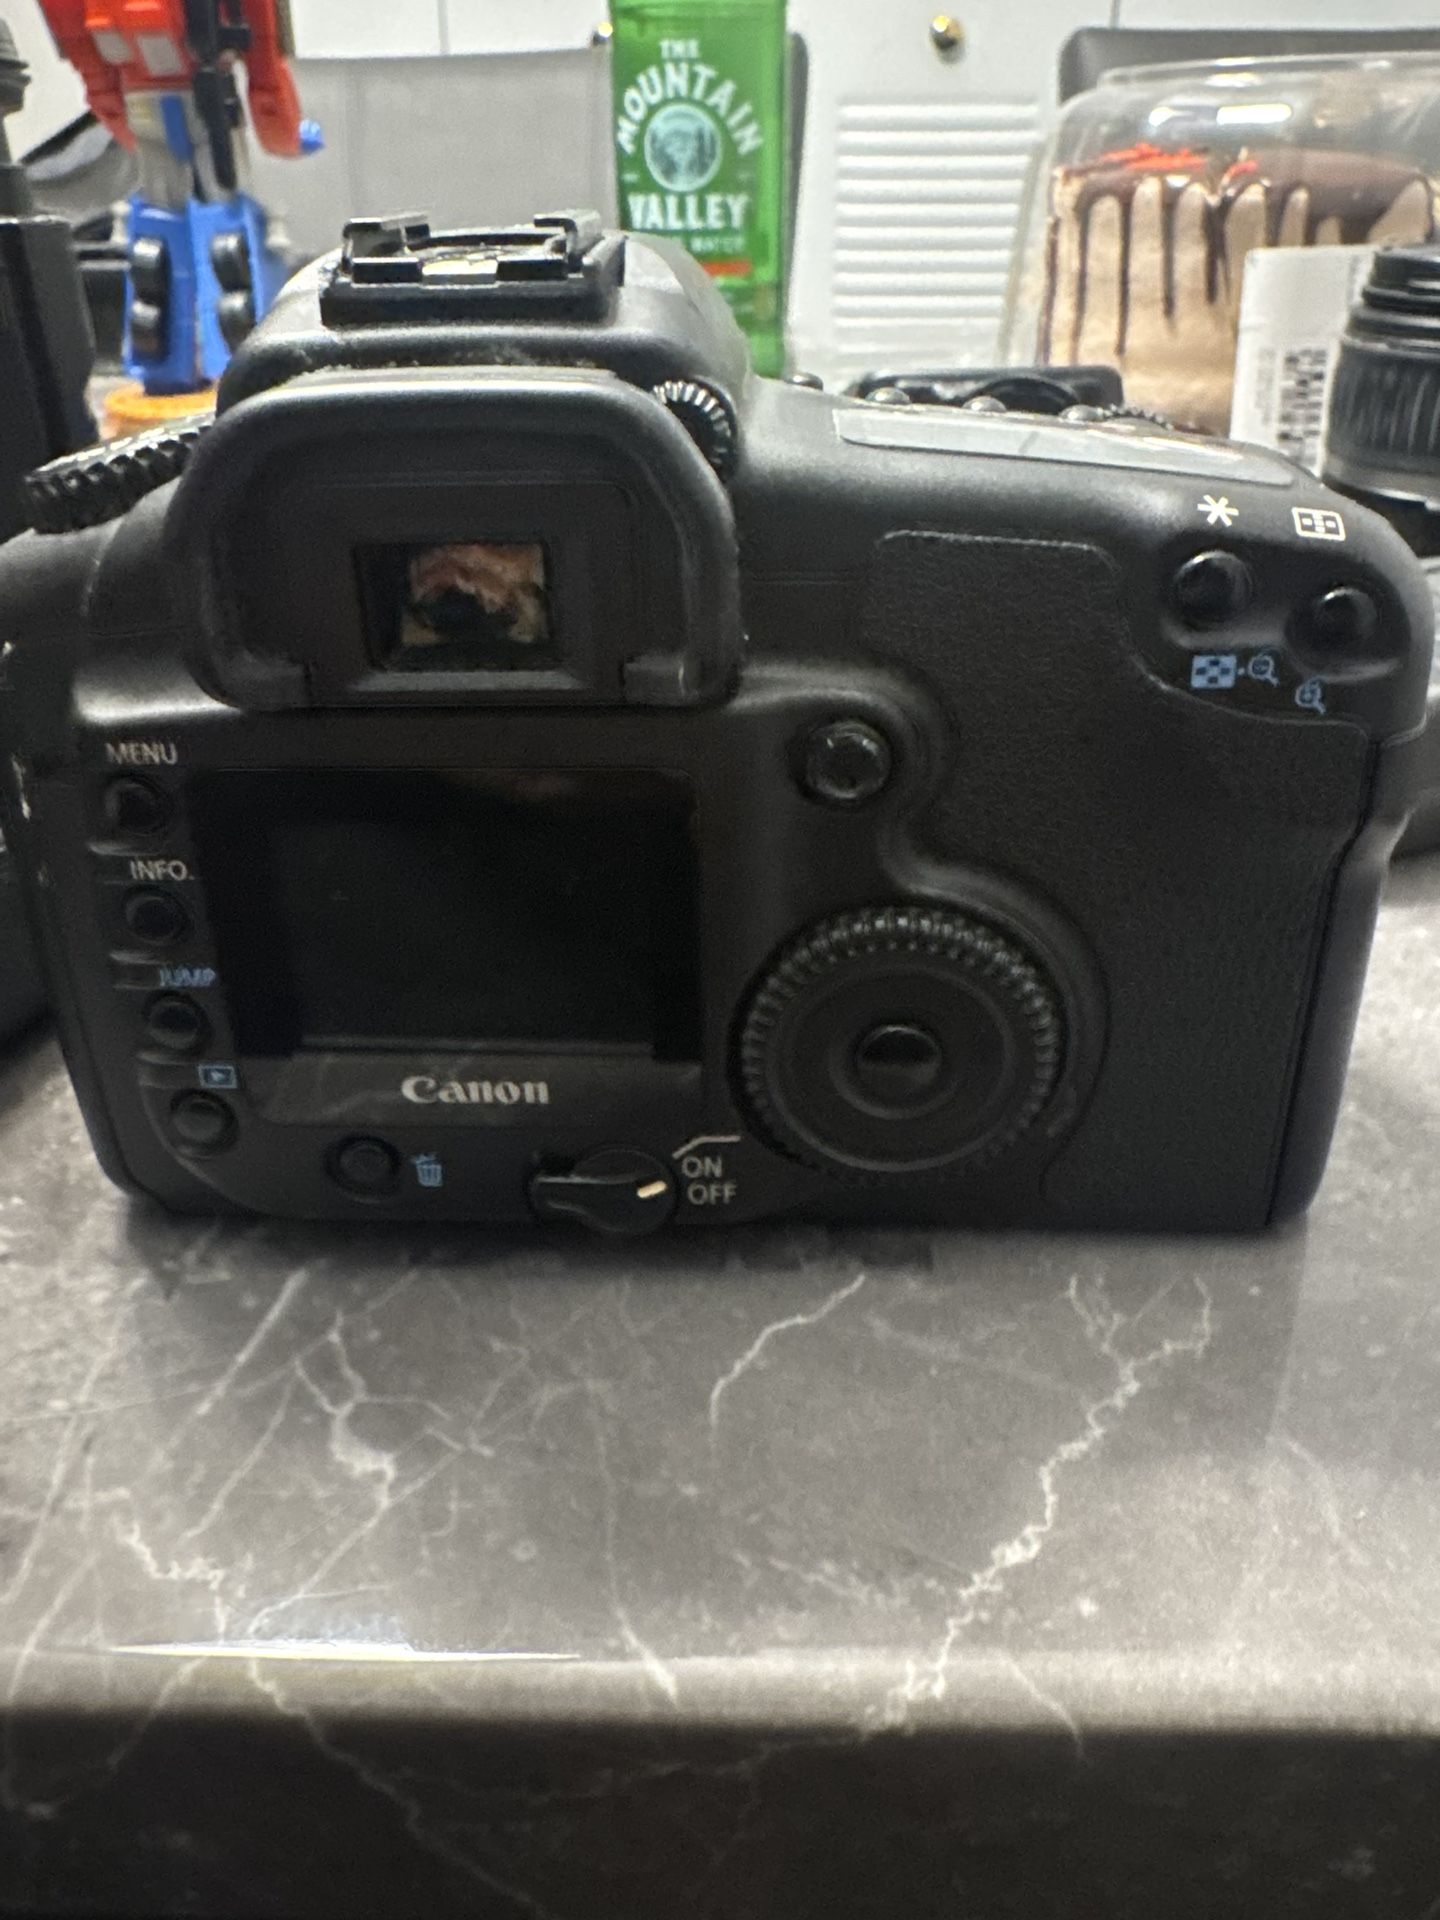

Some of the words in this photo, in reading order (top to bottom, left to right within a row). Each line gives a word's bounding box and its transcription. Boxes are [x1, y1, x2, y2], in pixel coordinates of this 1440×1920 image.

[660, 38, 699, 59] THE
[617, 62, 764, 155] MOUNTAIN
[627, 194, 748, 230] VALLEY
[104, 741, 178, 765] MENU
[130, 859, 195, 881] INFO.
[401, 1075, 550, 1104] Canon
[681, 1156, 723, 1178] ON
[687, 1183, 737, 1205] OFF
